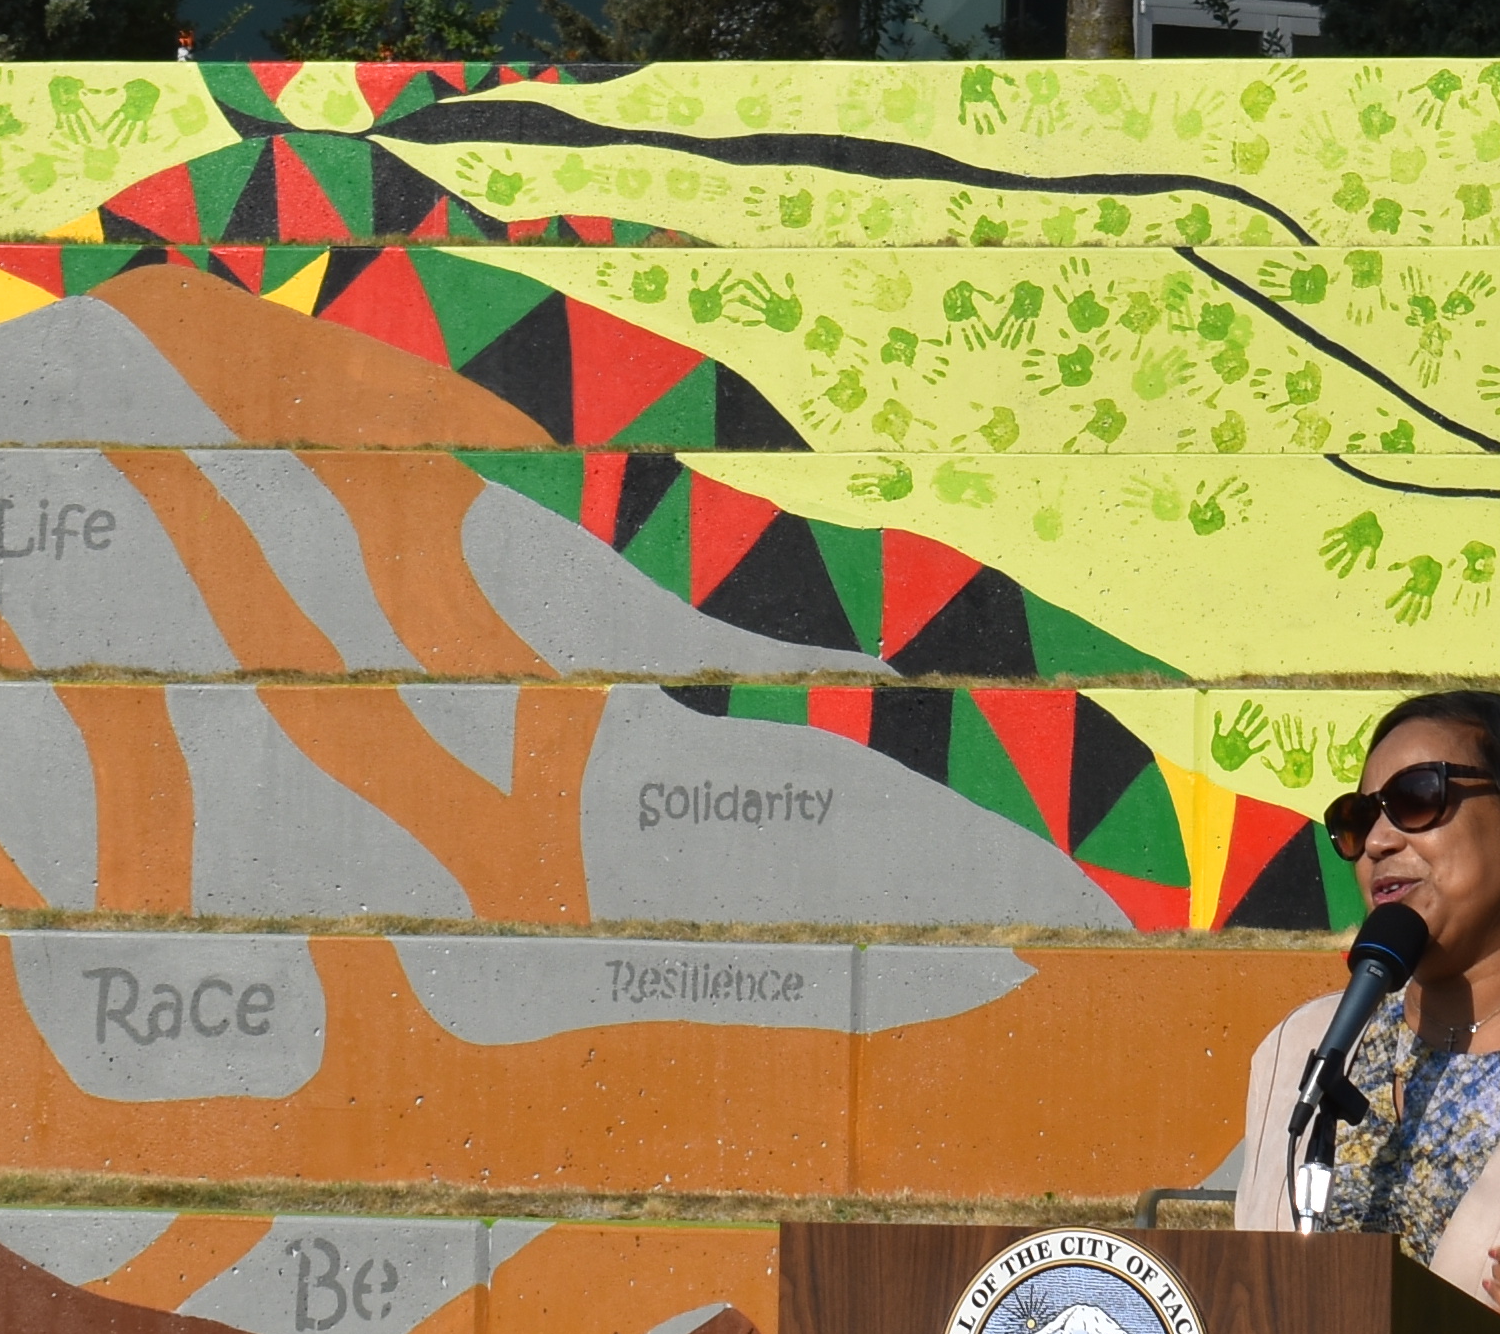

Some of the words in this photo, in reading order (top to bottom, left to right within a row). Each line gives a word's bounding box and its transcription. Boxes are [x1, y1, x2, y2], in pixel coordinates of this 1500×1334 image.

[638, 782, 834, 832] Solidarity
[81, 966, 277, 1047] Race
[604, 959, 805, 1004] Resilience
[284, 1236, 399, 1333] Be
[971, 1272, 1004, 1310] OF
[999, 1240, 1053, 1279] THE
[1059, 1236, 1122, 1264] CITY
[1126, 1256, 1159, 1285] OF
